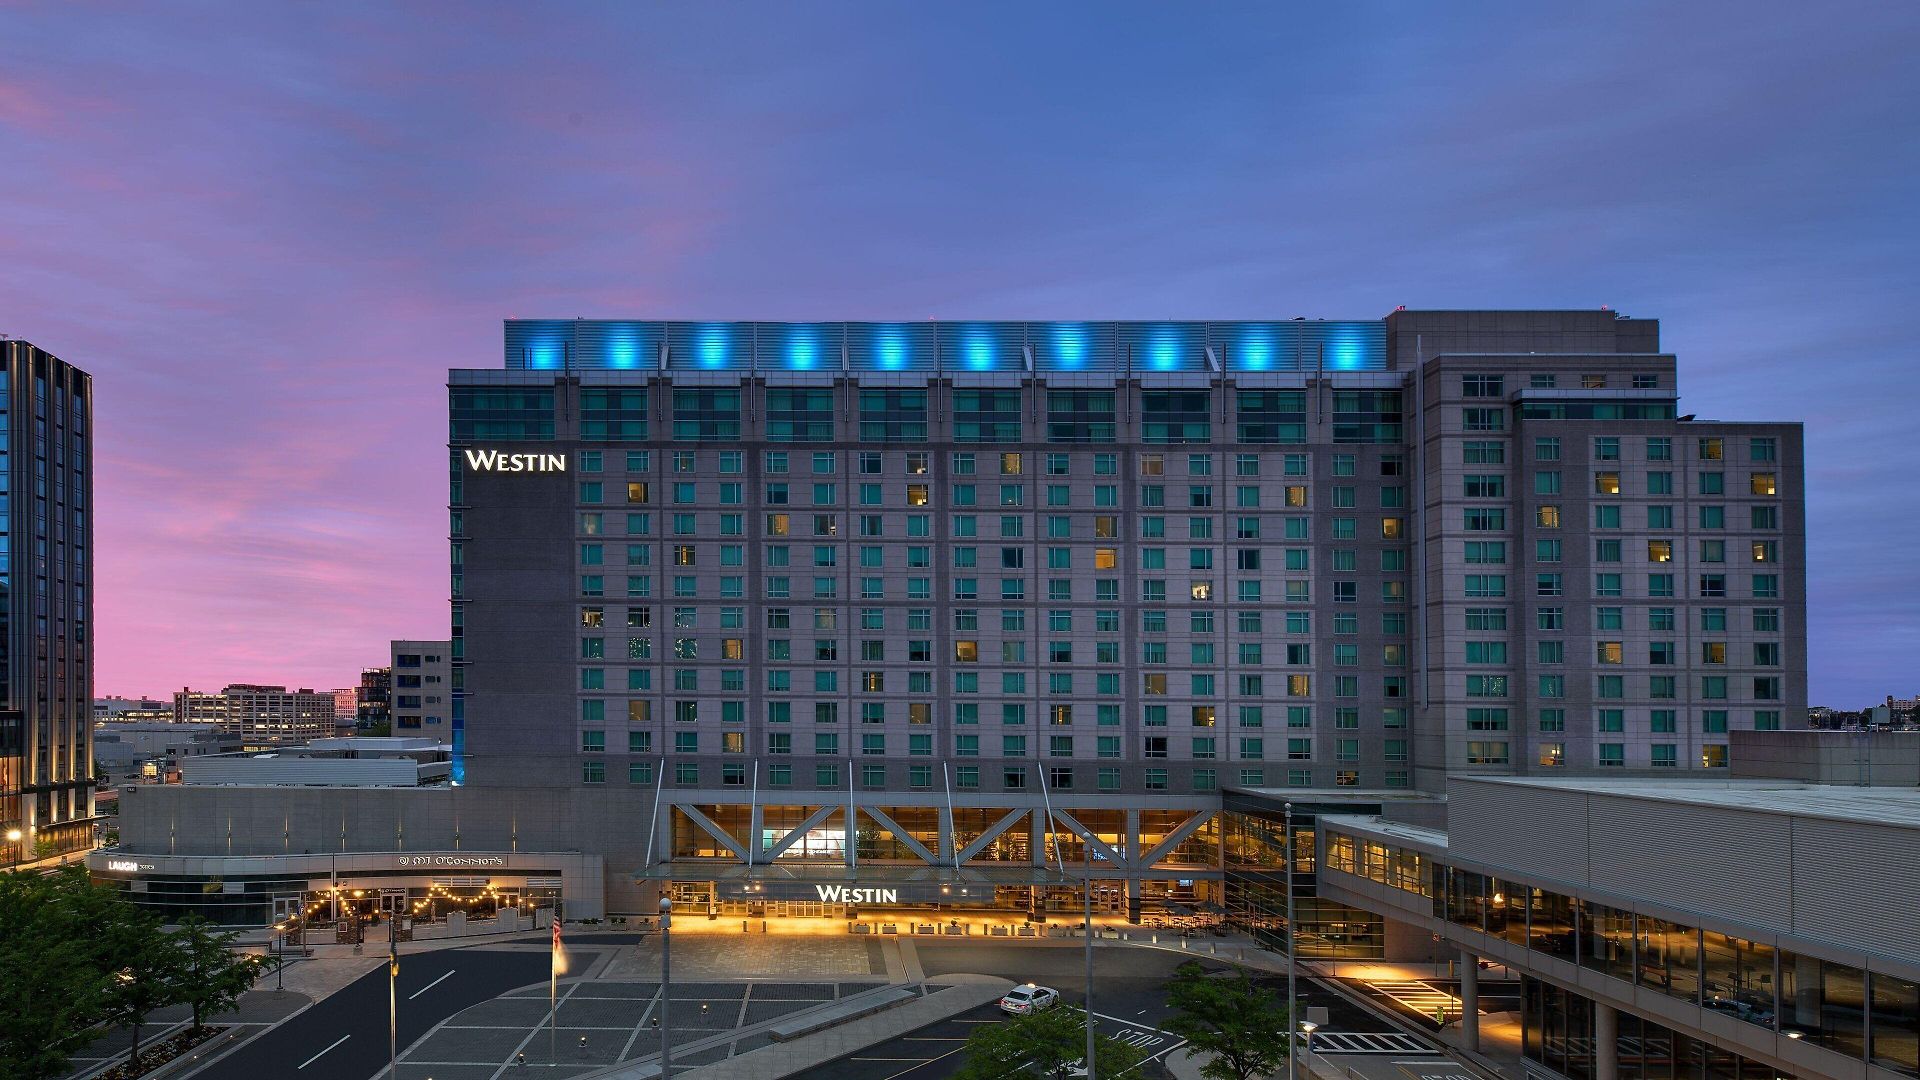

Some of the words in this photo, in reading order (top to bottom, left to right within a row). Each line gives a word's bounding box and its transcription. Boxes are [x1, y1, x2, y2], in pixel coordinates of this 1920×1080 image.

[464, 449, 566, 472] WESTIN
[108, 861, 138, 871] LAUGH
[815, 884, 897, 903] WESTIN
[1107, 1028, 1164, 1049] STOP
